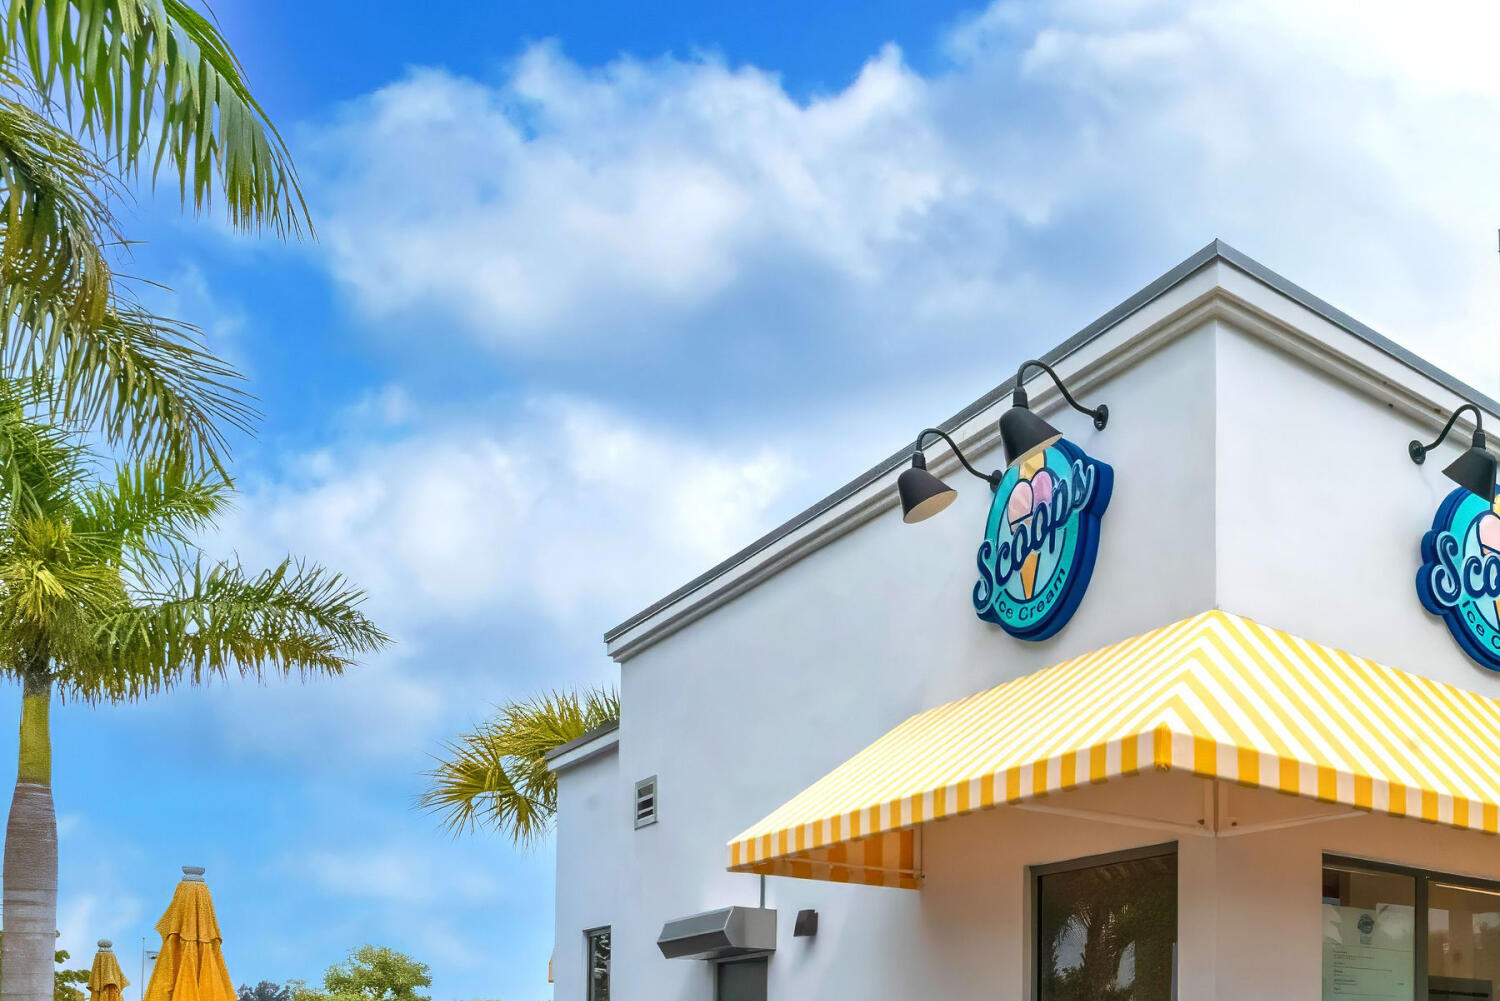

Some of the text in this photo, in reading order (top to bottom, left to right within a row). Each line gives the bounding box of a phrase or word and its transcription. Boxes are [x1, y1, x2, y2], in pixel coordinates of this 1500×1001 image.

[973, 460, 1094, 610] Scoops
[995, 568, 1066, 621] Ice Cream
[1461, 599, 1485, 636] Ice
